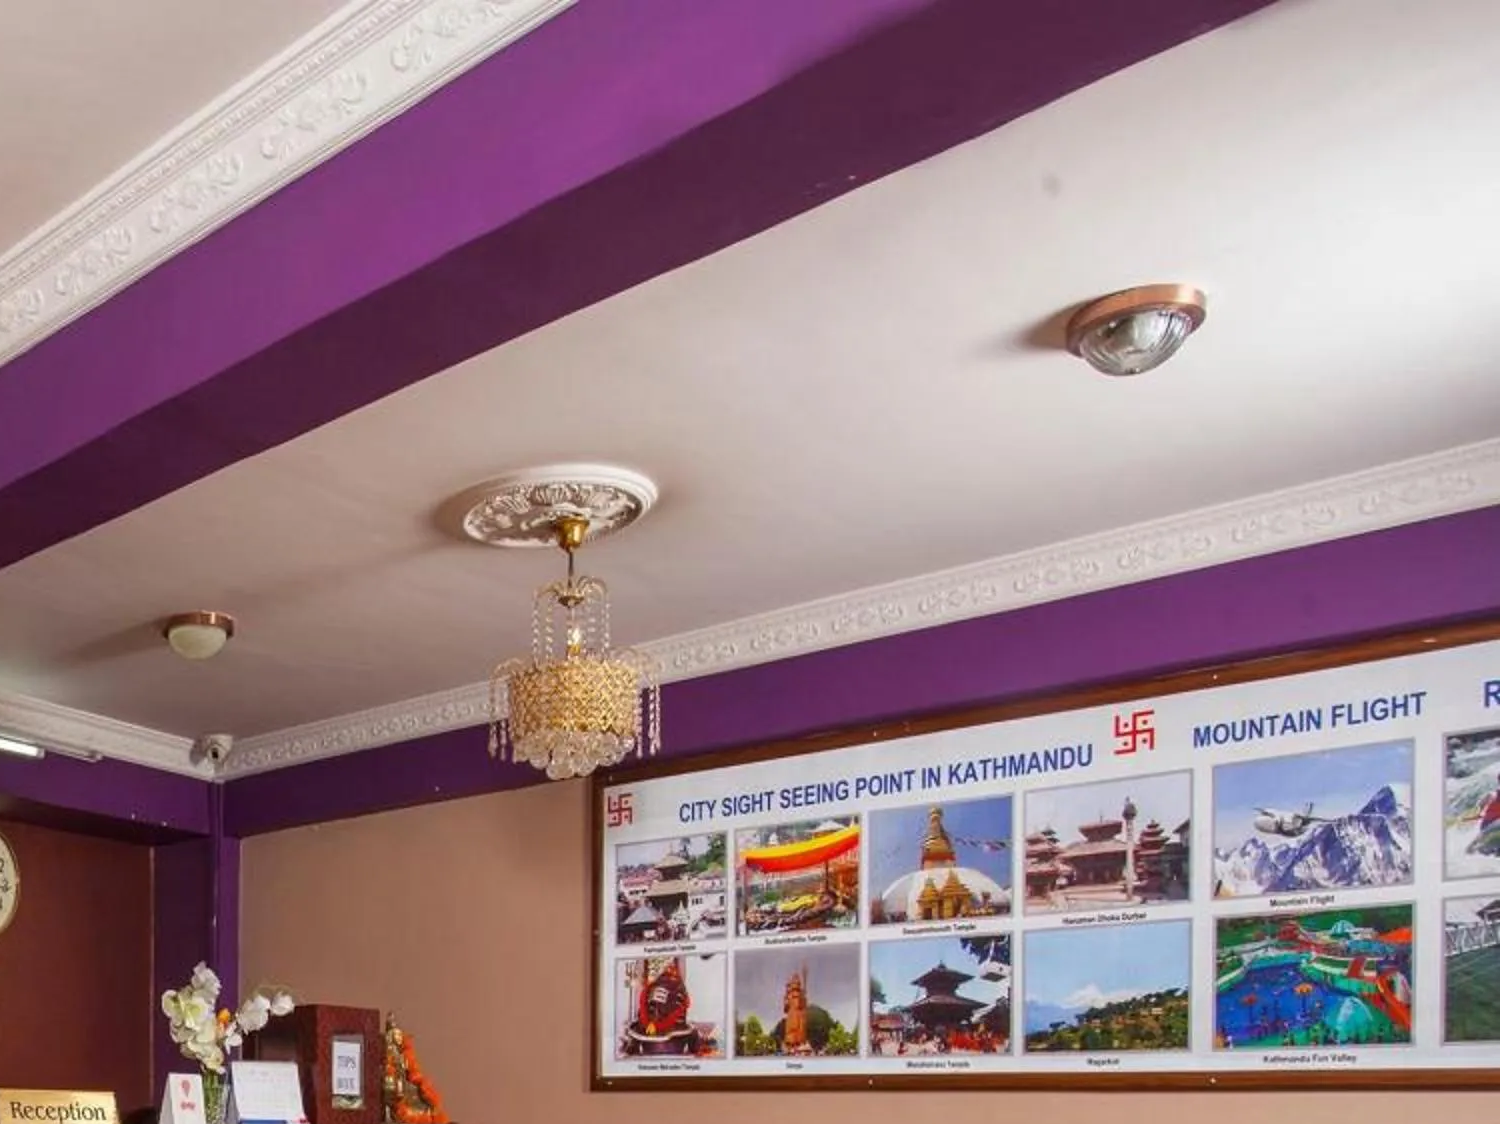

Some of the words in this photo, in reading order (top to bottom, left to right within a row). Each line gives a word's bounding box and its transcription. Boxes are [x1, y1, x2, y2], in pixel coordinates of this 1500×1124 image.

[1193, 708, 1321, 748] MOUNTAIN
[1331, 691, 1427, 728] FLIGHT
[680, 800, 716, 823] CITY
[722, 791, 774, 817] SIGHT
[780, 780, 849, 809] SEEING
[855, 769, 915, 799] POINT
[922, 765, 941, 789] IN
[948, 744, 1092, 785] KATHMANDU
[1270, 898, 1308, 906] Mountain
[1310, 896, 1334, 905] Flight
[1330, 1053, 1357, 1064] Valley
[10, 1101, 107, 1124] Reception
